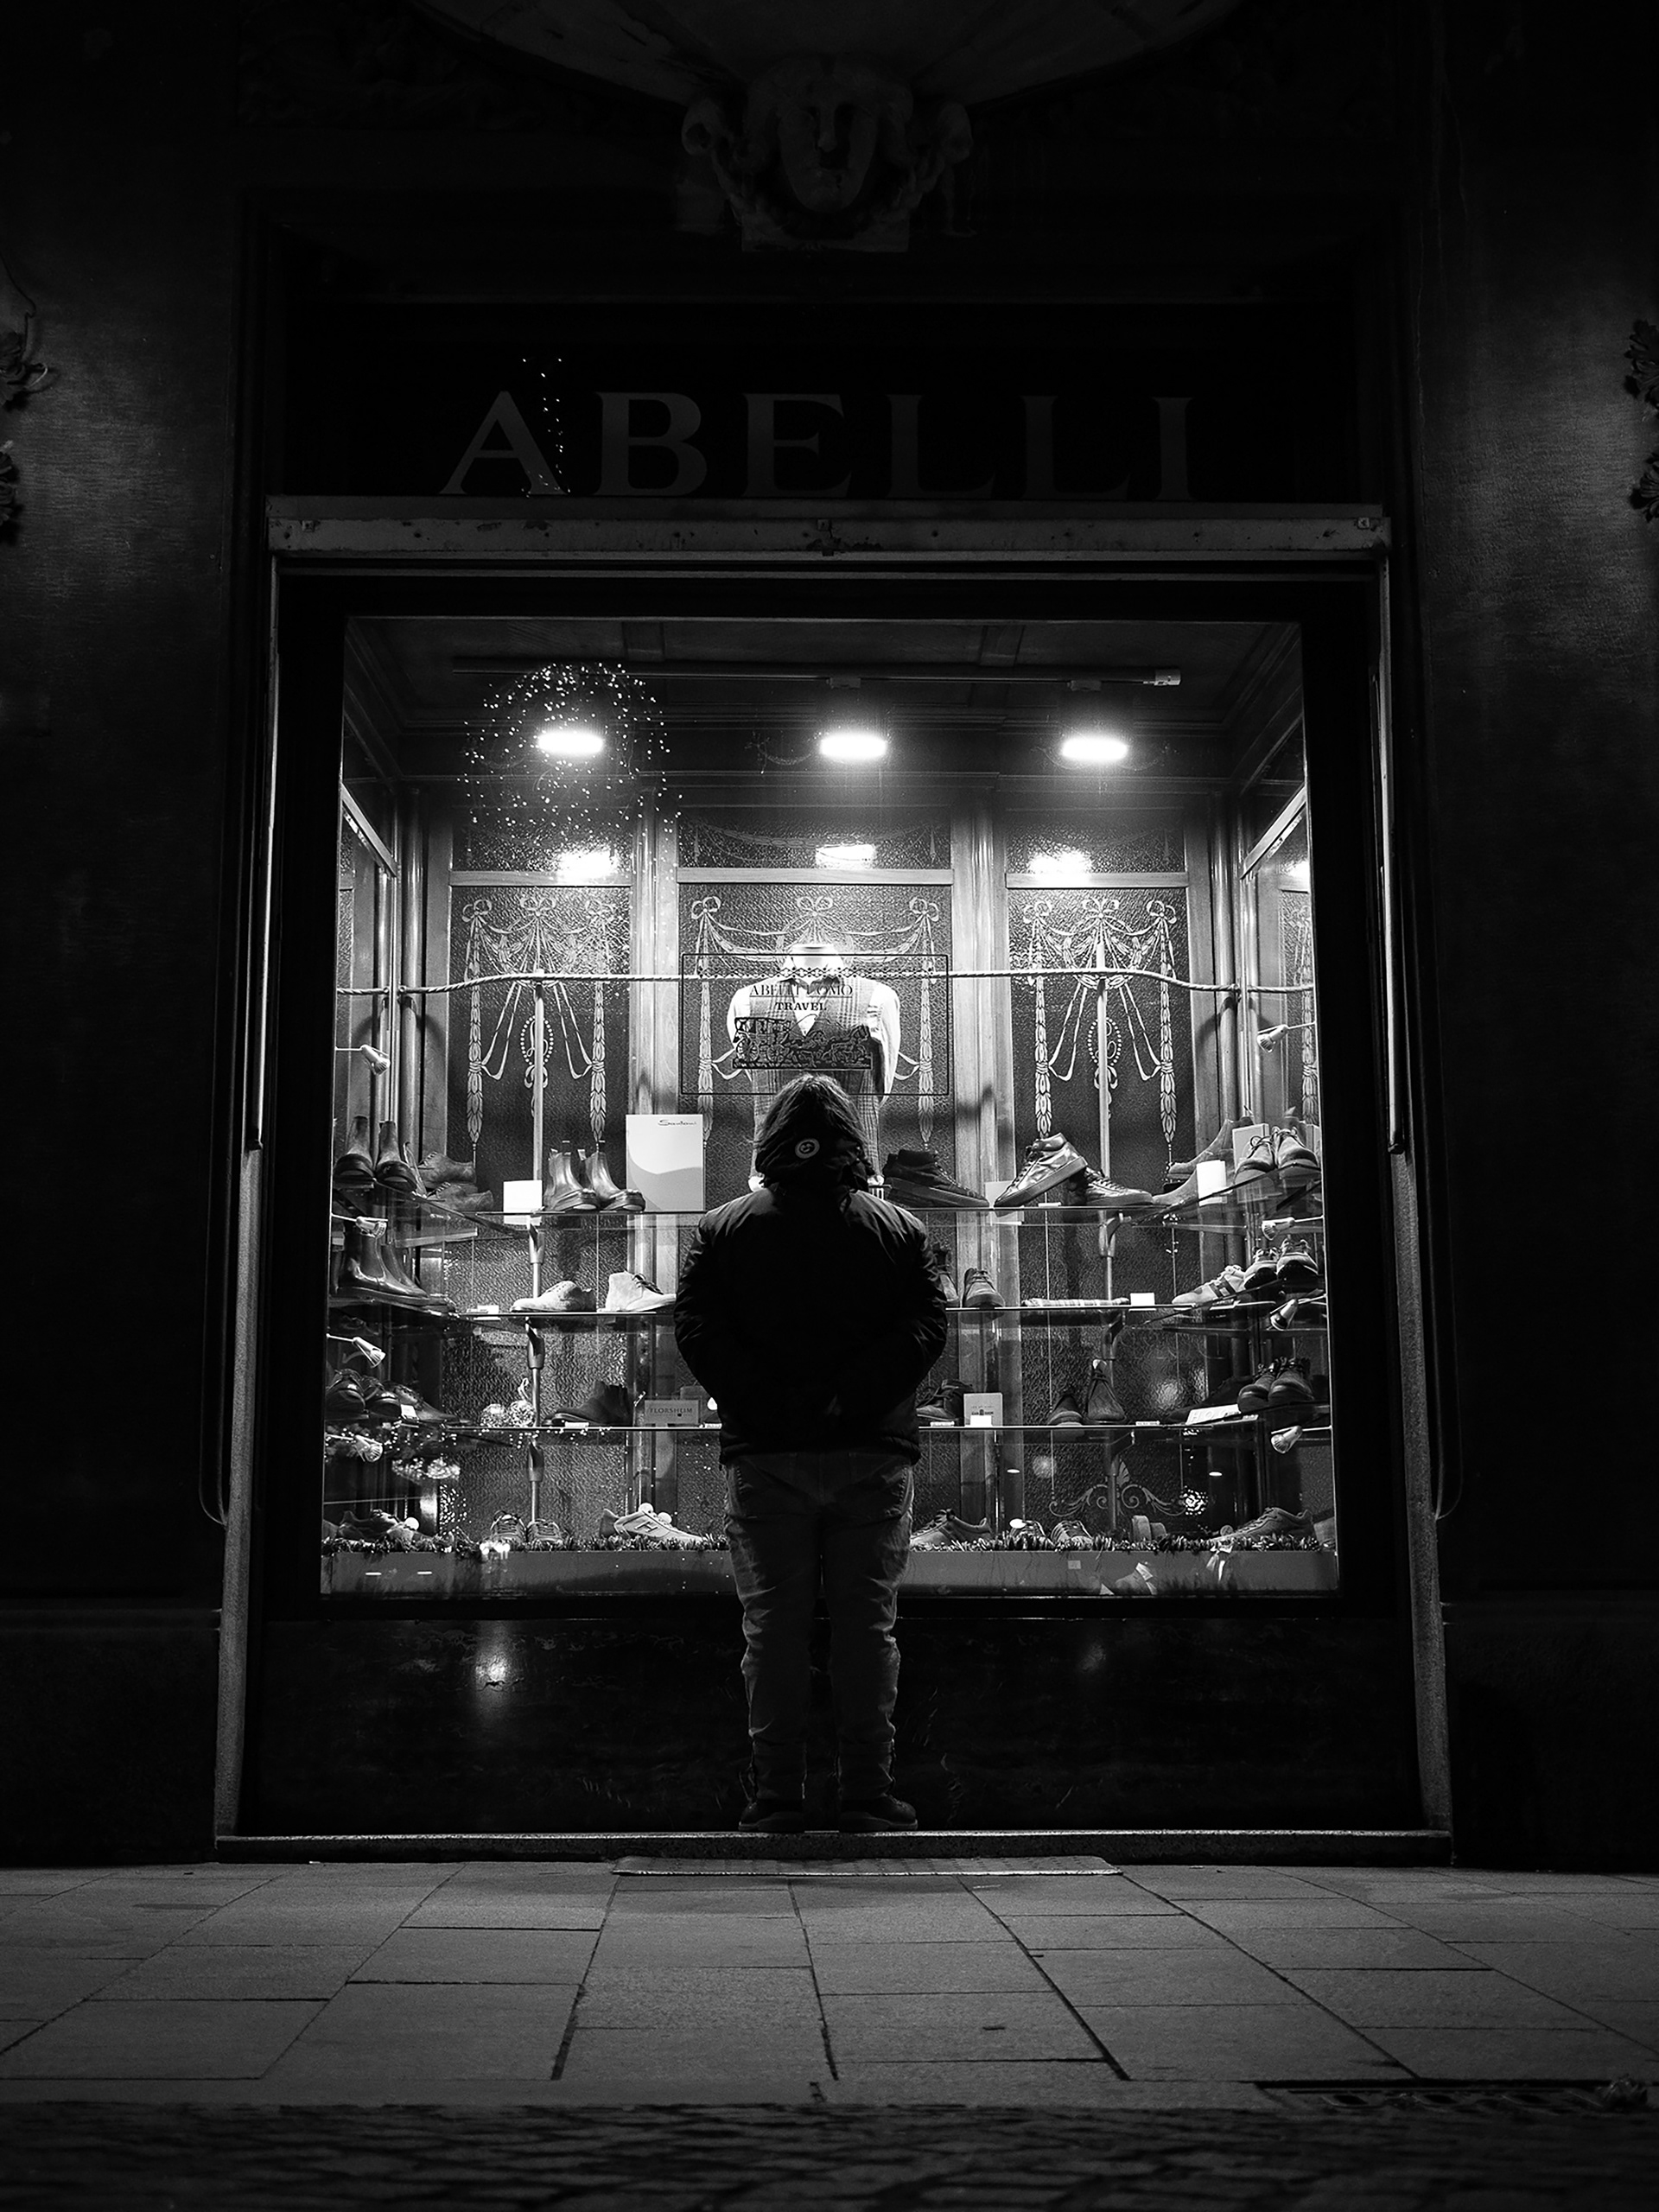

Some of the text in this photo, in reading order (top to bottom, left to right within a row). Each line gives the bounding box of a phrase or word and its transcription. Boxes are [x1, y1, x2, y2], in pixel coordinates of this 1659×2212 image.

[436, 391, 1199, 503] ABELLI
[749, 984, 800, 996] ABELLI
[775, 1001, 827, 1011] TRAVEL
